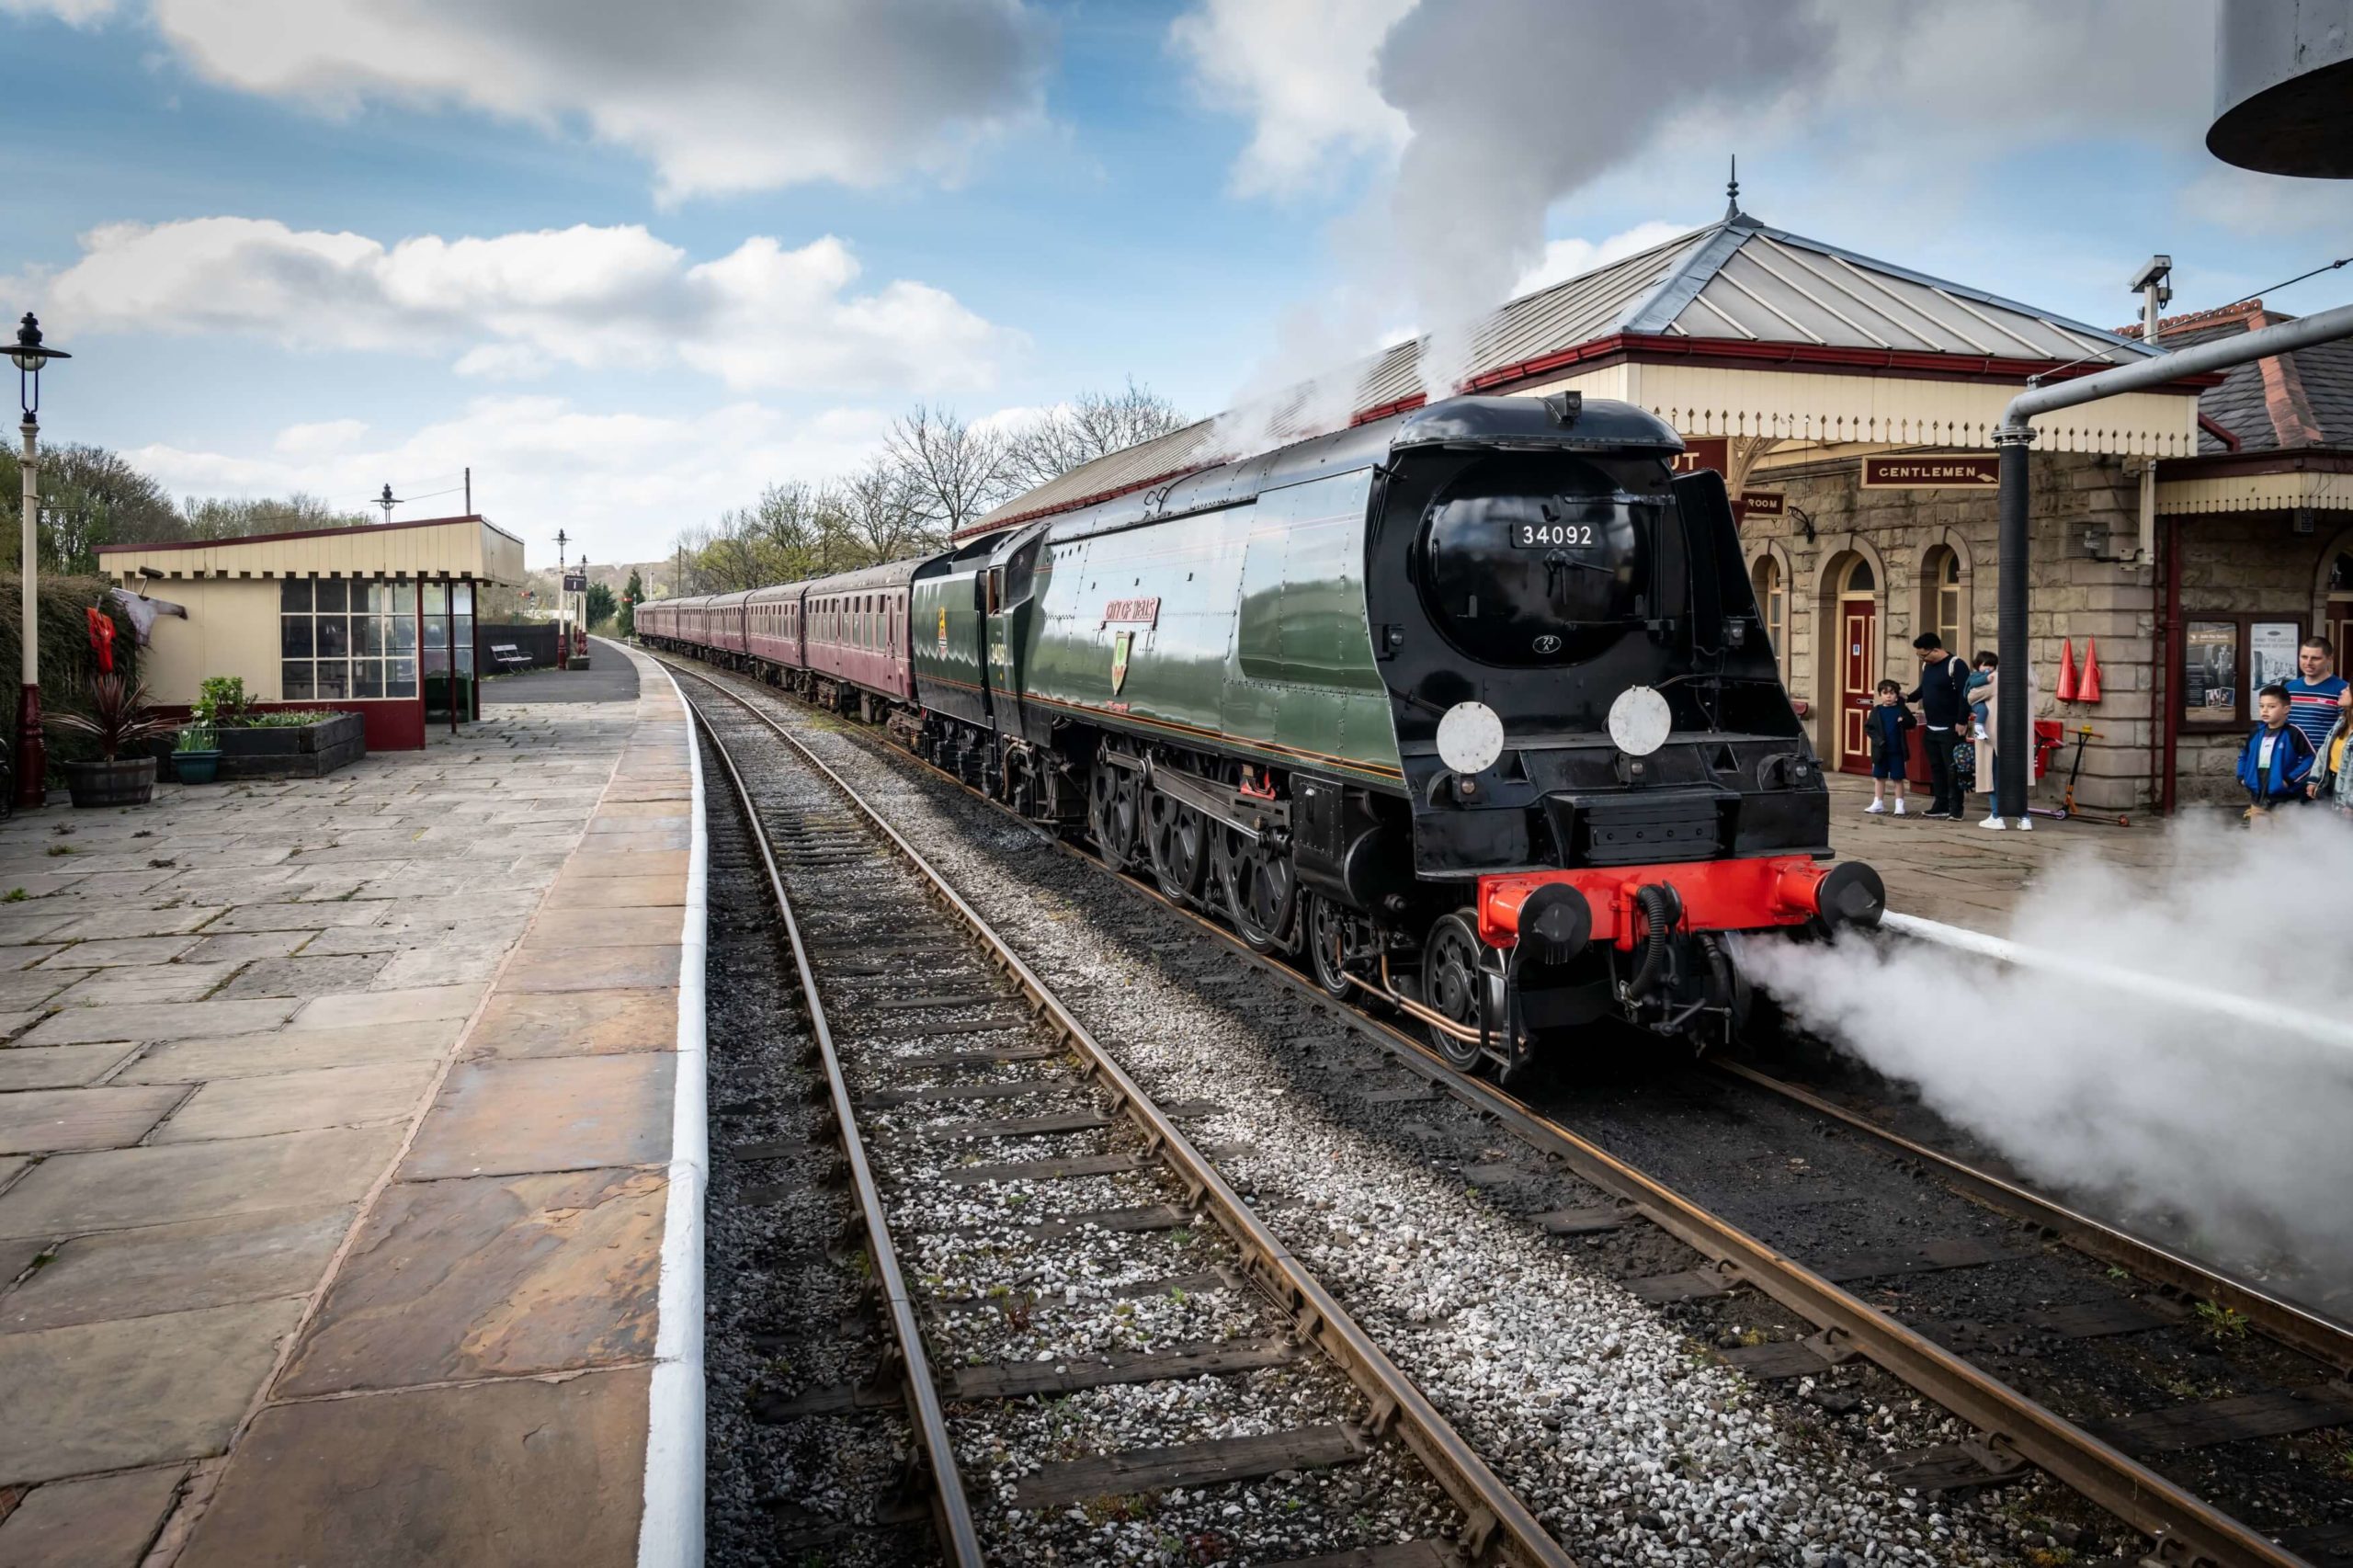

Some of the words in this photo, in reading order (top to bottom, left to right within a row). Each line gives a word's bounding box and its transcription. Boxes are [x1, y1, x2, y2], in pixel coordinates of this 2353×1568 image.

[1879, 467, 1975, 477] GENTLEMEN
[1748, 498, 1778, 508] ROOM
[1523, 526, 1592, 544] 34092
[1106, 601, 1121, 619] CITY
[1121, 600, 1132, 619] OF
[1132, 597, 1154, 619] WELLS
[1543, 637, 1553, 645] 73
